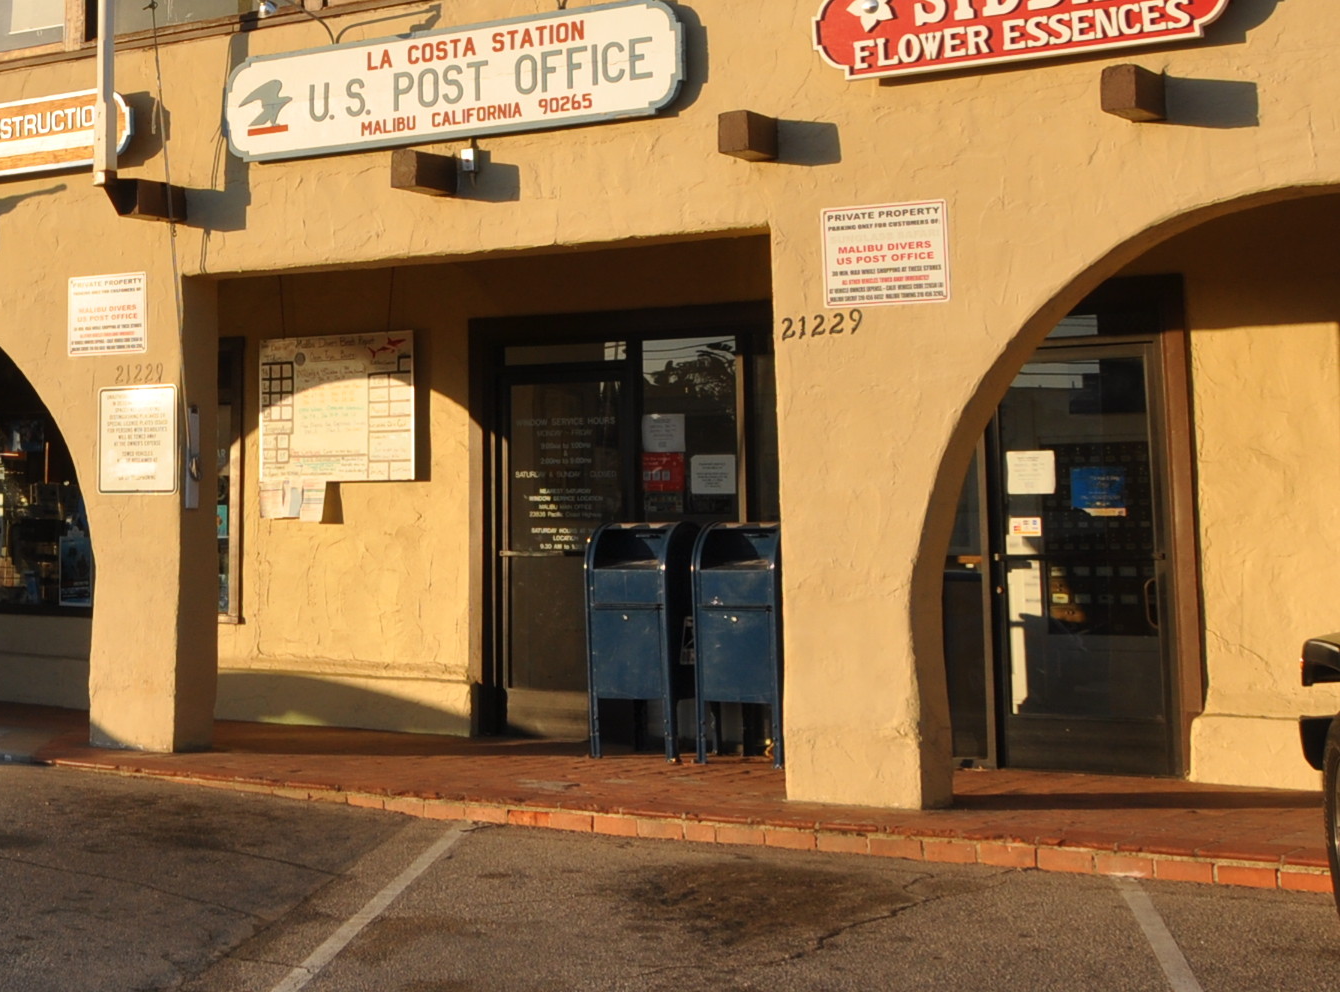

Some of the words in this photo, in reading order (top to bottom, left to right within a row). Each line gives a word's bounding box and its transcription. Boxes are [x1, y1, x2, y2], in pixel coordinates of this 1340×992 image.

[366, 49, 393, 71] LA
[407, 38, 476, 65] COSTA
[491, 20, 585, 54] STATION
[853, 25, 991, 70] FLOWER
[308, 78, 372, 123] U.S.
[393, 60, 489, 112] POST
[514, 36, 653, 96] OFFICE
[360, 116, 416, 137] MALIBU
[431, 102, 523, 128] CALIFORNIA
[538, 93, 593, 115] 90265
[827, 211, 875, 222] PRIVATE
[878, 206, 940, 219] PROPERTY
[828, 224, 856, 232] PARKING
[888, 219, 929, 228] CUSTOMERS
[838, 244, 883, 254] MALIBU
[887, 240, 932, 251] DIVERS
[836, 257, 852, 266] US
[856, 254, 887, 264] POST
[891, 251, 934, 262] OFFICE
[104, 277, 142, 286] PROPERTY
[79, 306, 106, 314] MALIBU
[109, 304, 137, 312] DIVERS
[111, 312, 138, 320] OFFICE
[781, 308, 863, 341] 21229
[516, 418, 548, 427] WINDOW
[551, 417, 584, 426] SERVICE
[587, 416, 616, 425] HOURS
[589, 470, 617, 478] CLOSED
